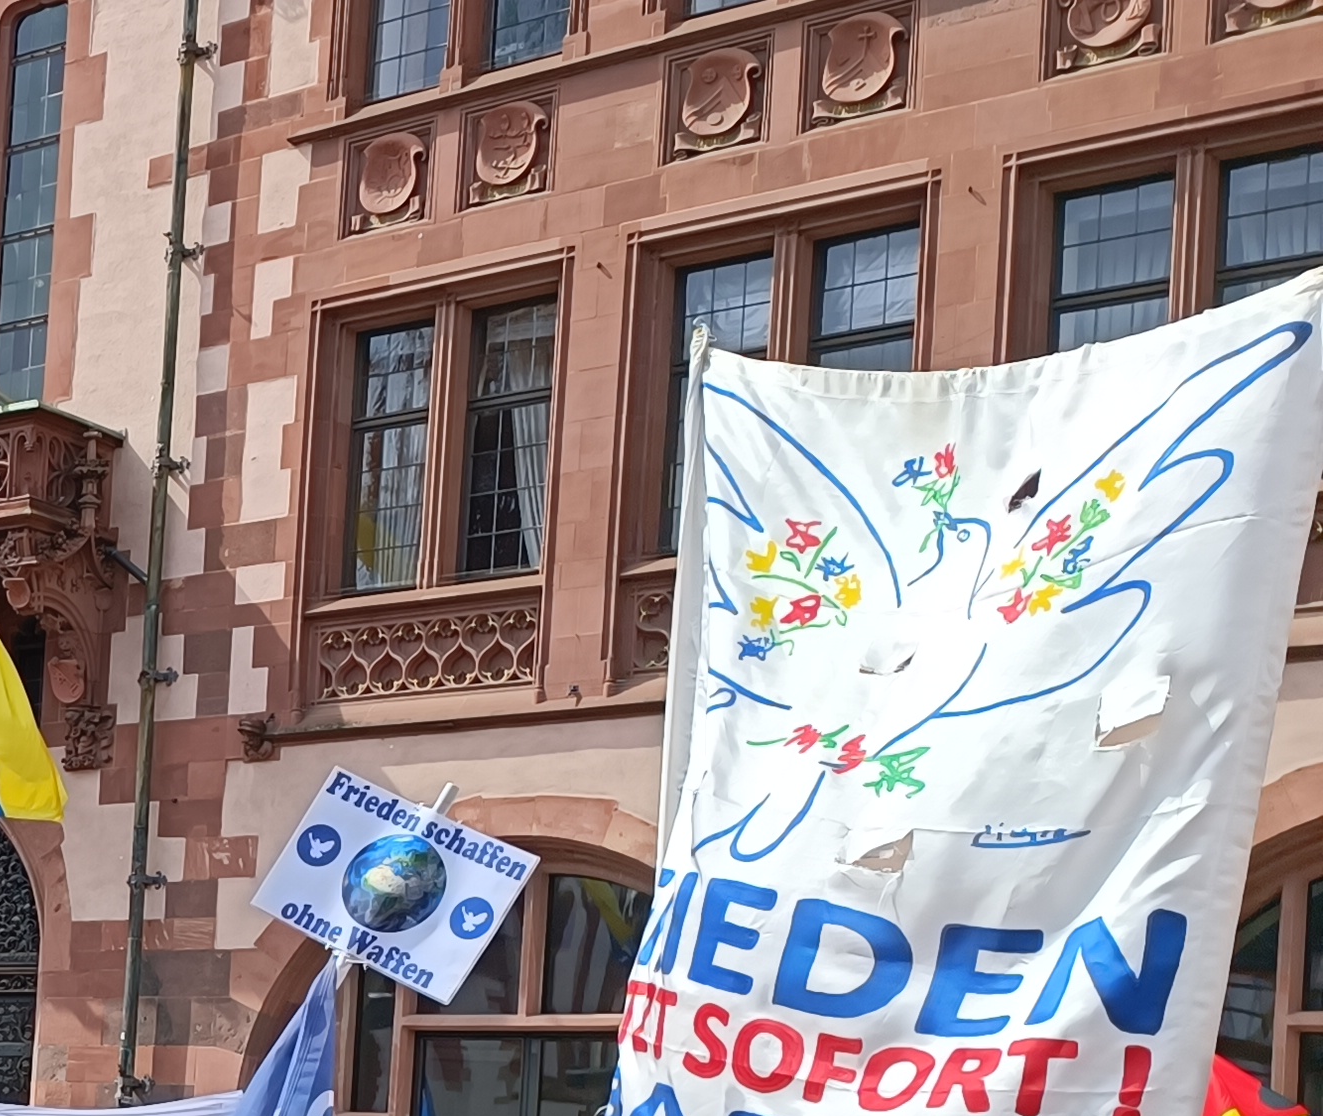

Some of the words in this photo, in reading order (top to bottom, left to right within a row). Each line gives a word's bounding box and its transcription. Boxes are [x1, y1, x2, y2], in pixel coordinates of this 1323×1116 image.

[326, 772, 421, 832] Frieden
[422, 821, 528, 881] schaffen
[281, 902, 343, 942] ohne
[347, 925, 434, 989] Waffen
